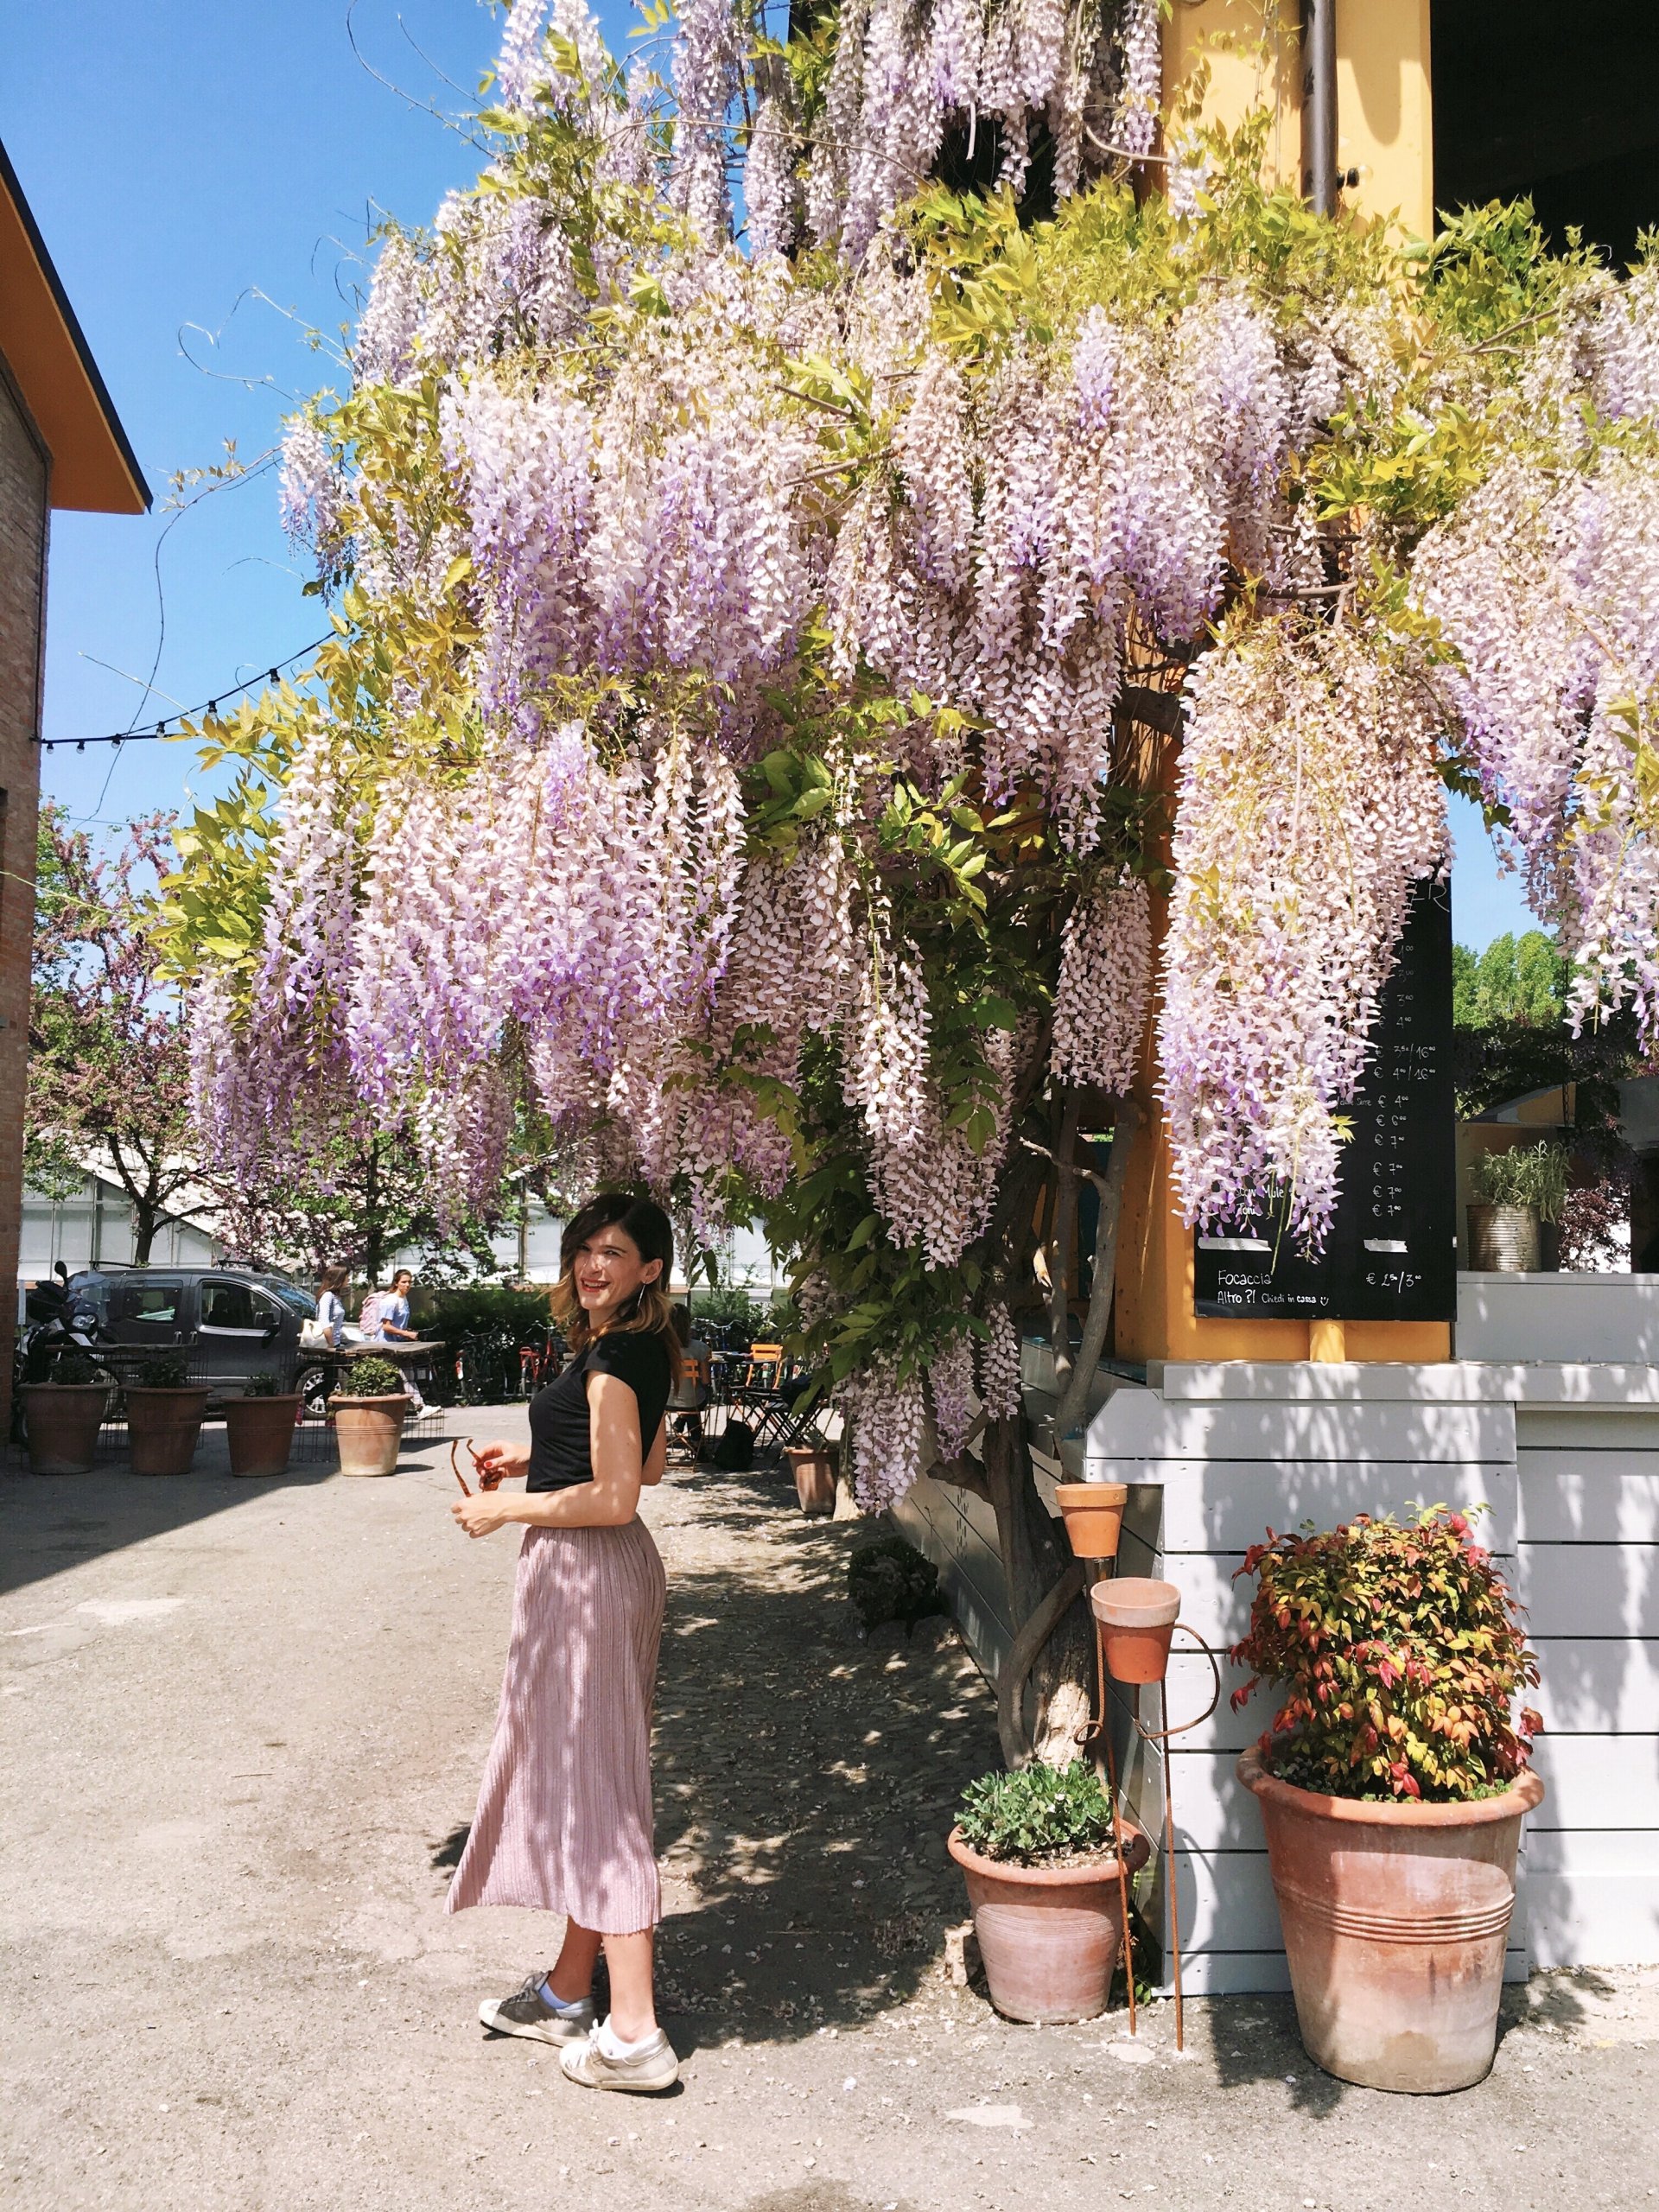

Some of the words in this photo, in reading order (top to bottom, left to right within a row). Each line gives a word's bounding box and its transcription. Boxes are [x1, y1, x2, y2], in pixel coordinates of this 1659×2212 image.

[1373, 1066, 1384, 1078] €
[1377, 1095, 1387, 1108] €
[1376, 1114, 1385, 1127] €
[1375, 1134, 1383, 1147] €
[1373, 1161, 1382, 1176] €
[1373, 1185, 1382, 1198] €
[1372, 1204, 1382, 1217] €
[1217, 1269, 1273, 1286] Focaccia
[1365, 1272, 1376, 1285] €
[1217, 1289, 1243, 1305] Altro
[1261, 1293, 1285, 1304] Chiedi
[1287, 1294, 1295, 1304] in
[1296, 1295, 1317, 1304] cassa
